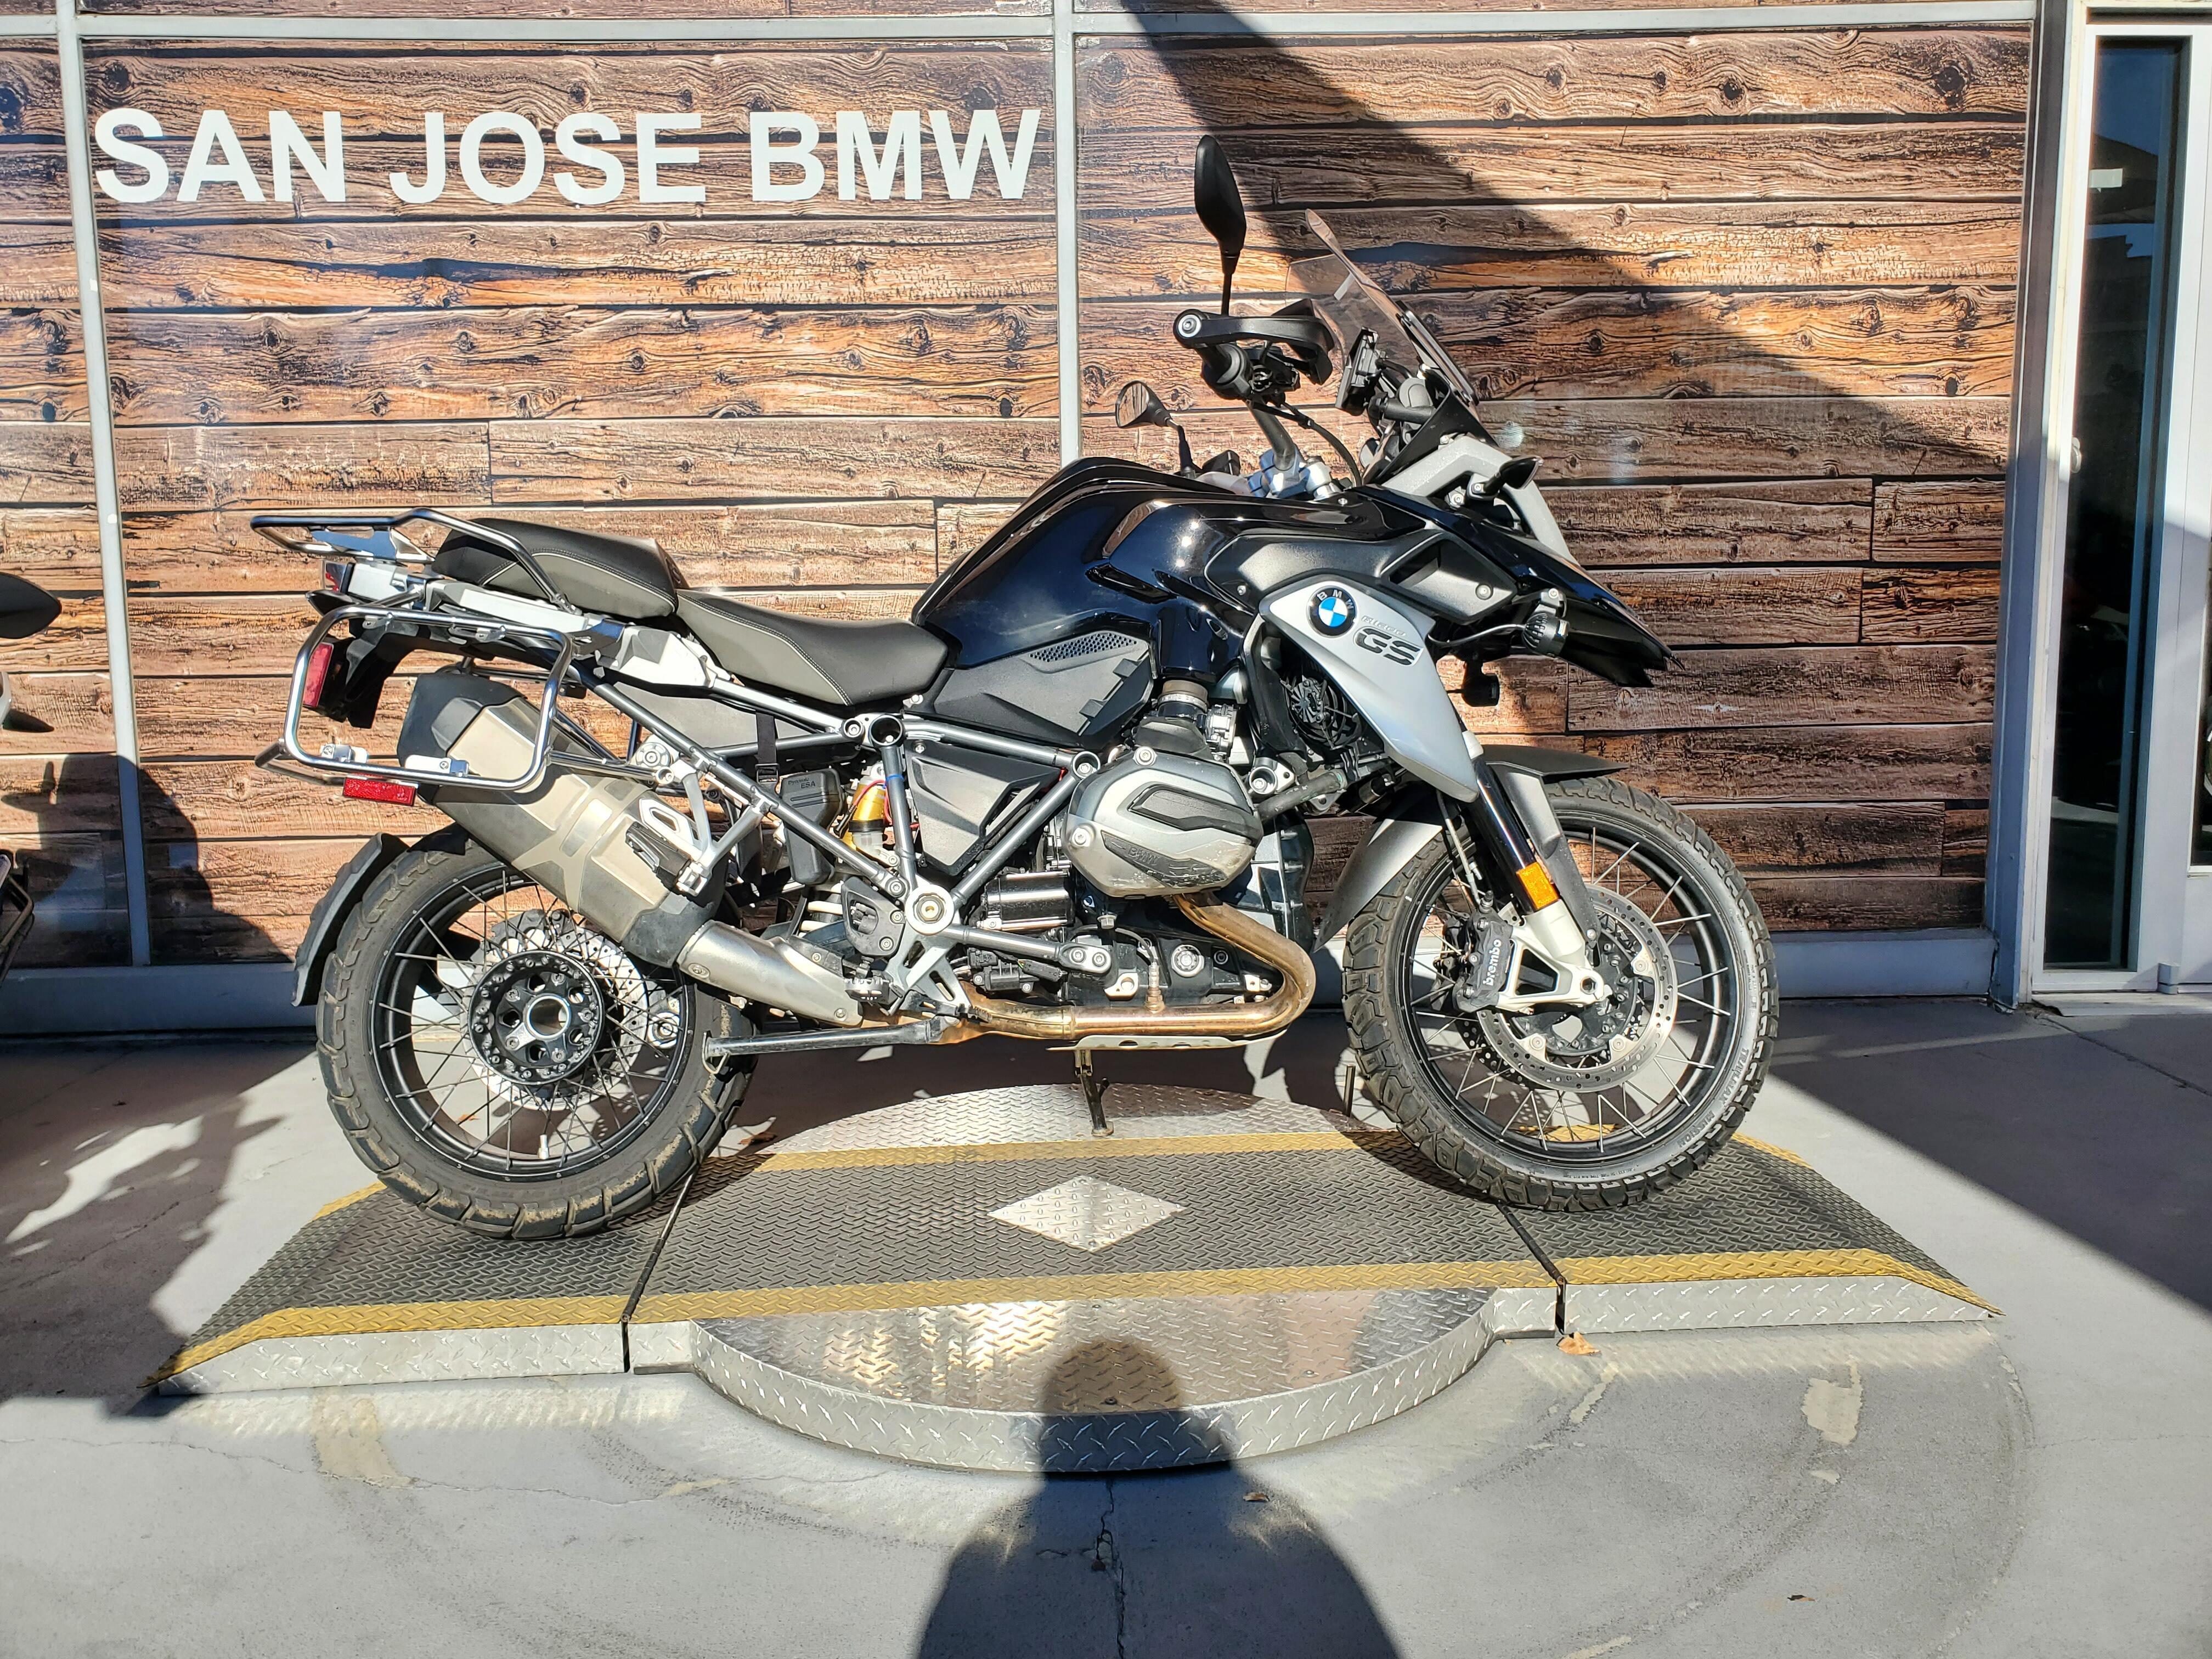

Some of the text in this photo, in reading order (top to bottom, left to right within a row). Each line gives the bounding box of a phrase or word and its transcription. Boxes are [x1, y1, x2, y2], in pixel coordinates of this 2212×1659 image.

[94, 108, 1042, 205] SAN JOSE BMW
[1317, 589, 1354, 610] BMW
[1355, 628, 1421, 666] GS
[1128, 847, 1160, 865] BMW
[1482, 939, 1502, 986] brembo
[1675, 1110, 1716, 1148] MISSION
